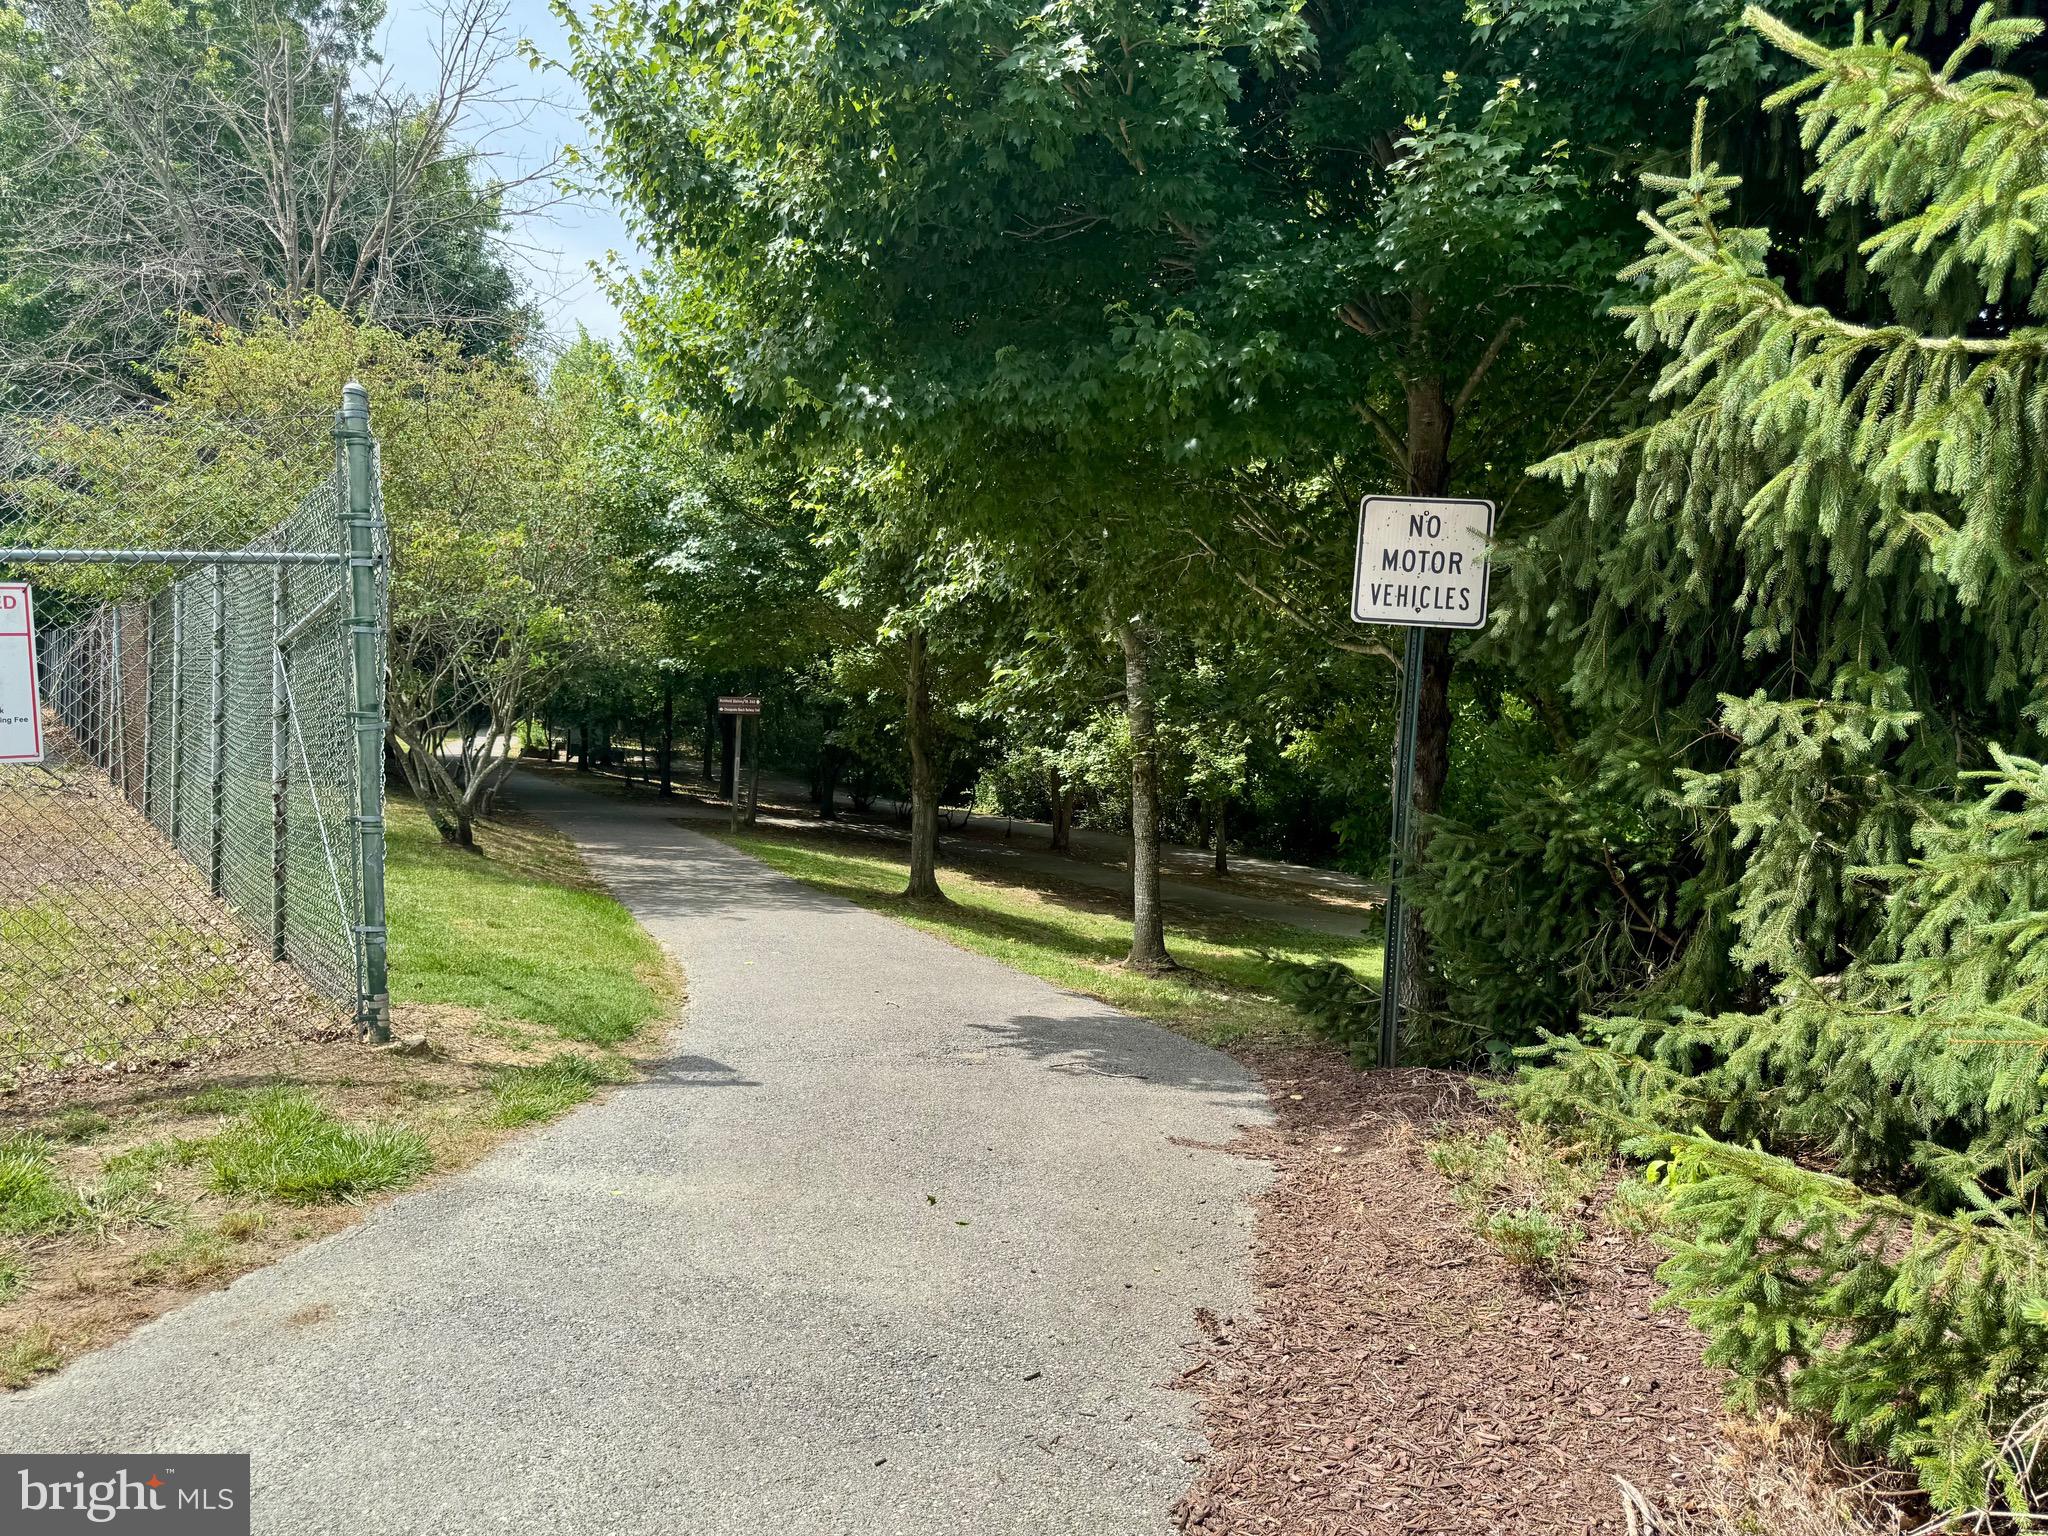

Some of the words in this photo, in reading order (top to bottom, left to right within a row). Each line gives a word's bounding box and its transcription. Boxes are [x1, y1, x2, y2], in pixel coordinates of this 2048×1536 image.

[1409, 514, 1441, 538] NO
[1382, 549, 1463, 575] MOTOR
[1371, 583, 1470, 611] VEHICLES
